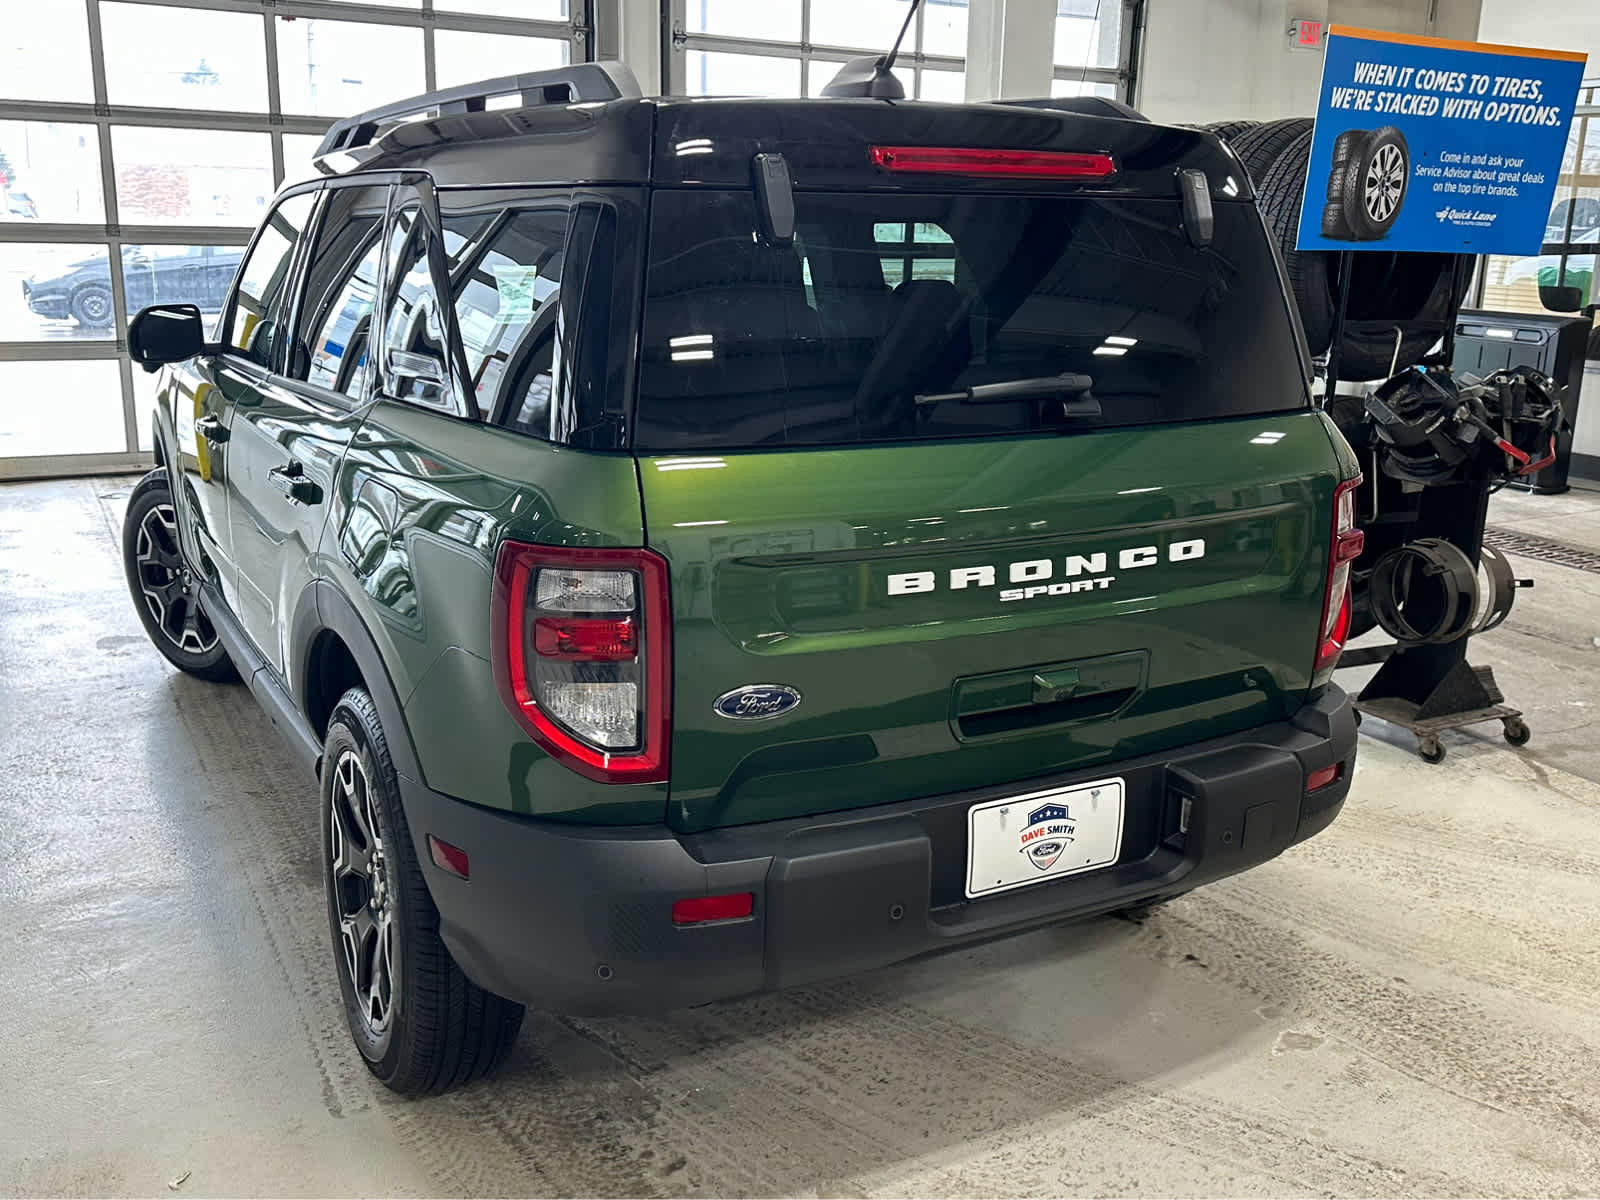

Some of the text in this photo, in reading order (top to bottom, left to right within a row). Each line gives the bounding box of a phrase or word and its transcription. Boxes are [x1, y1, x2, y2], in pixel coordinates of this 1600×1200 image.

[1299, 21, 1321, 46] EXIT
[1353, 61, 1543, 104] WHEN IT COMES TO TIRES,
[1330, 86, 1561, 127] WE'RE STACKED WITH OPTIONS.
[1440, 151, 1525, 169] Come in and ask your
[1415, 164, 1545, 184] Service Advisor about great deals
[1433, 181, 1519, 197] on the top tire brands.
[1448, 209, 1497, 221] Quick Lane
[887, 539, 1205, 595] BRONCO
[999, 576, 1115, 602] SPORT
[735, 692, 782, 714] Ford
[1021, 825, 1075, 843] DAVE SMITH
